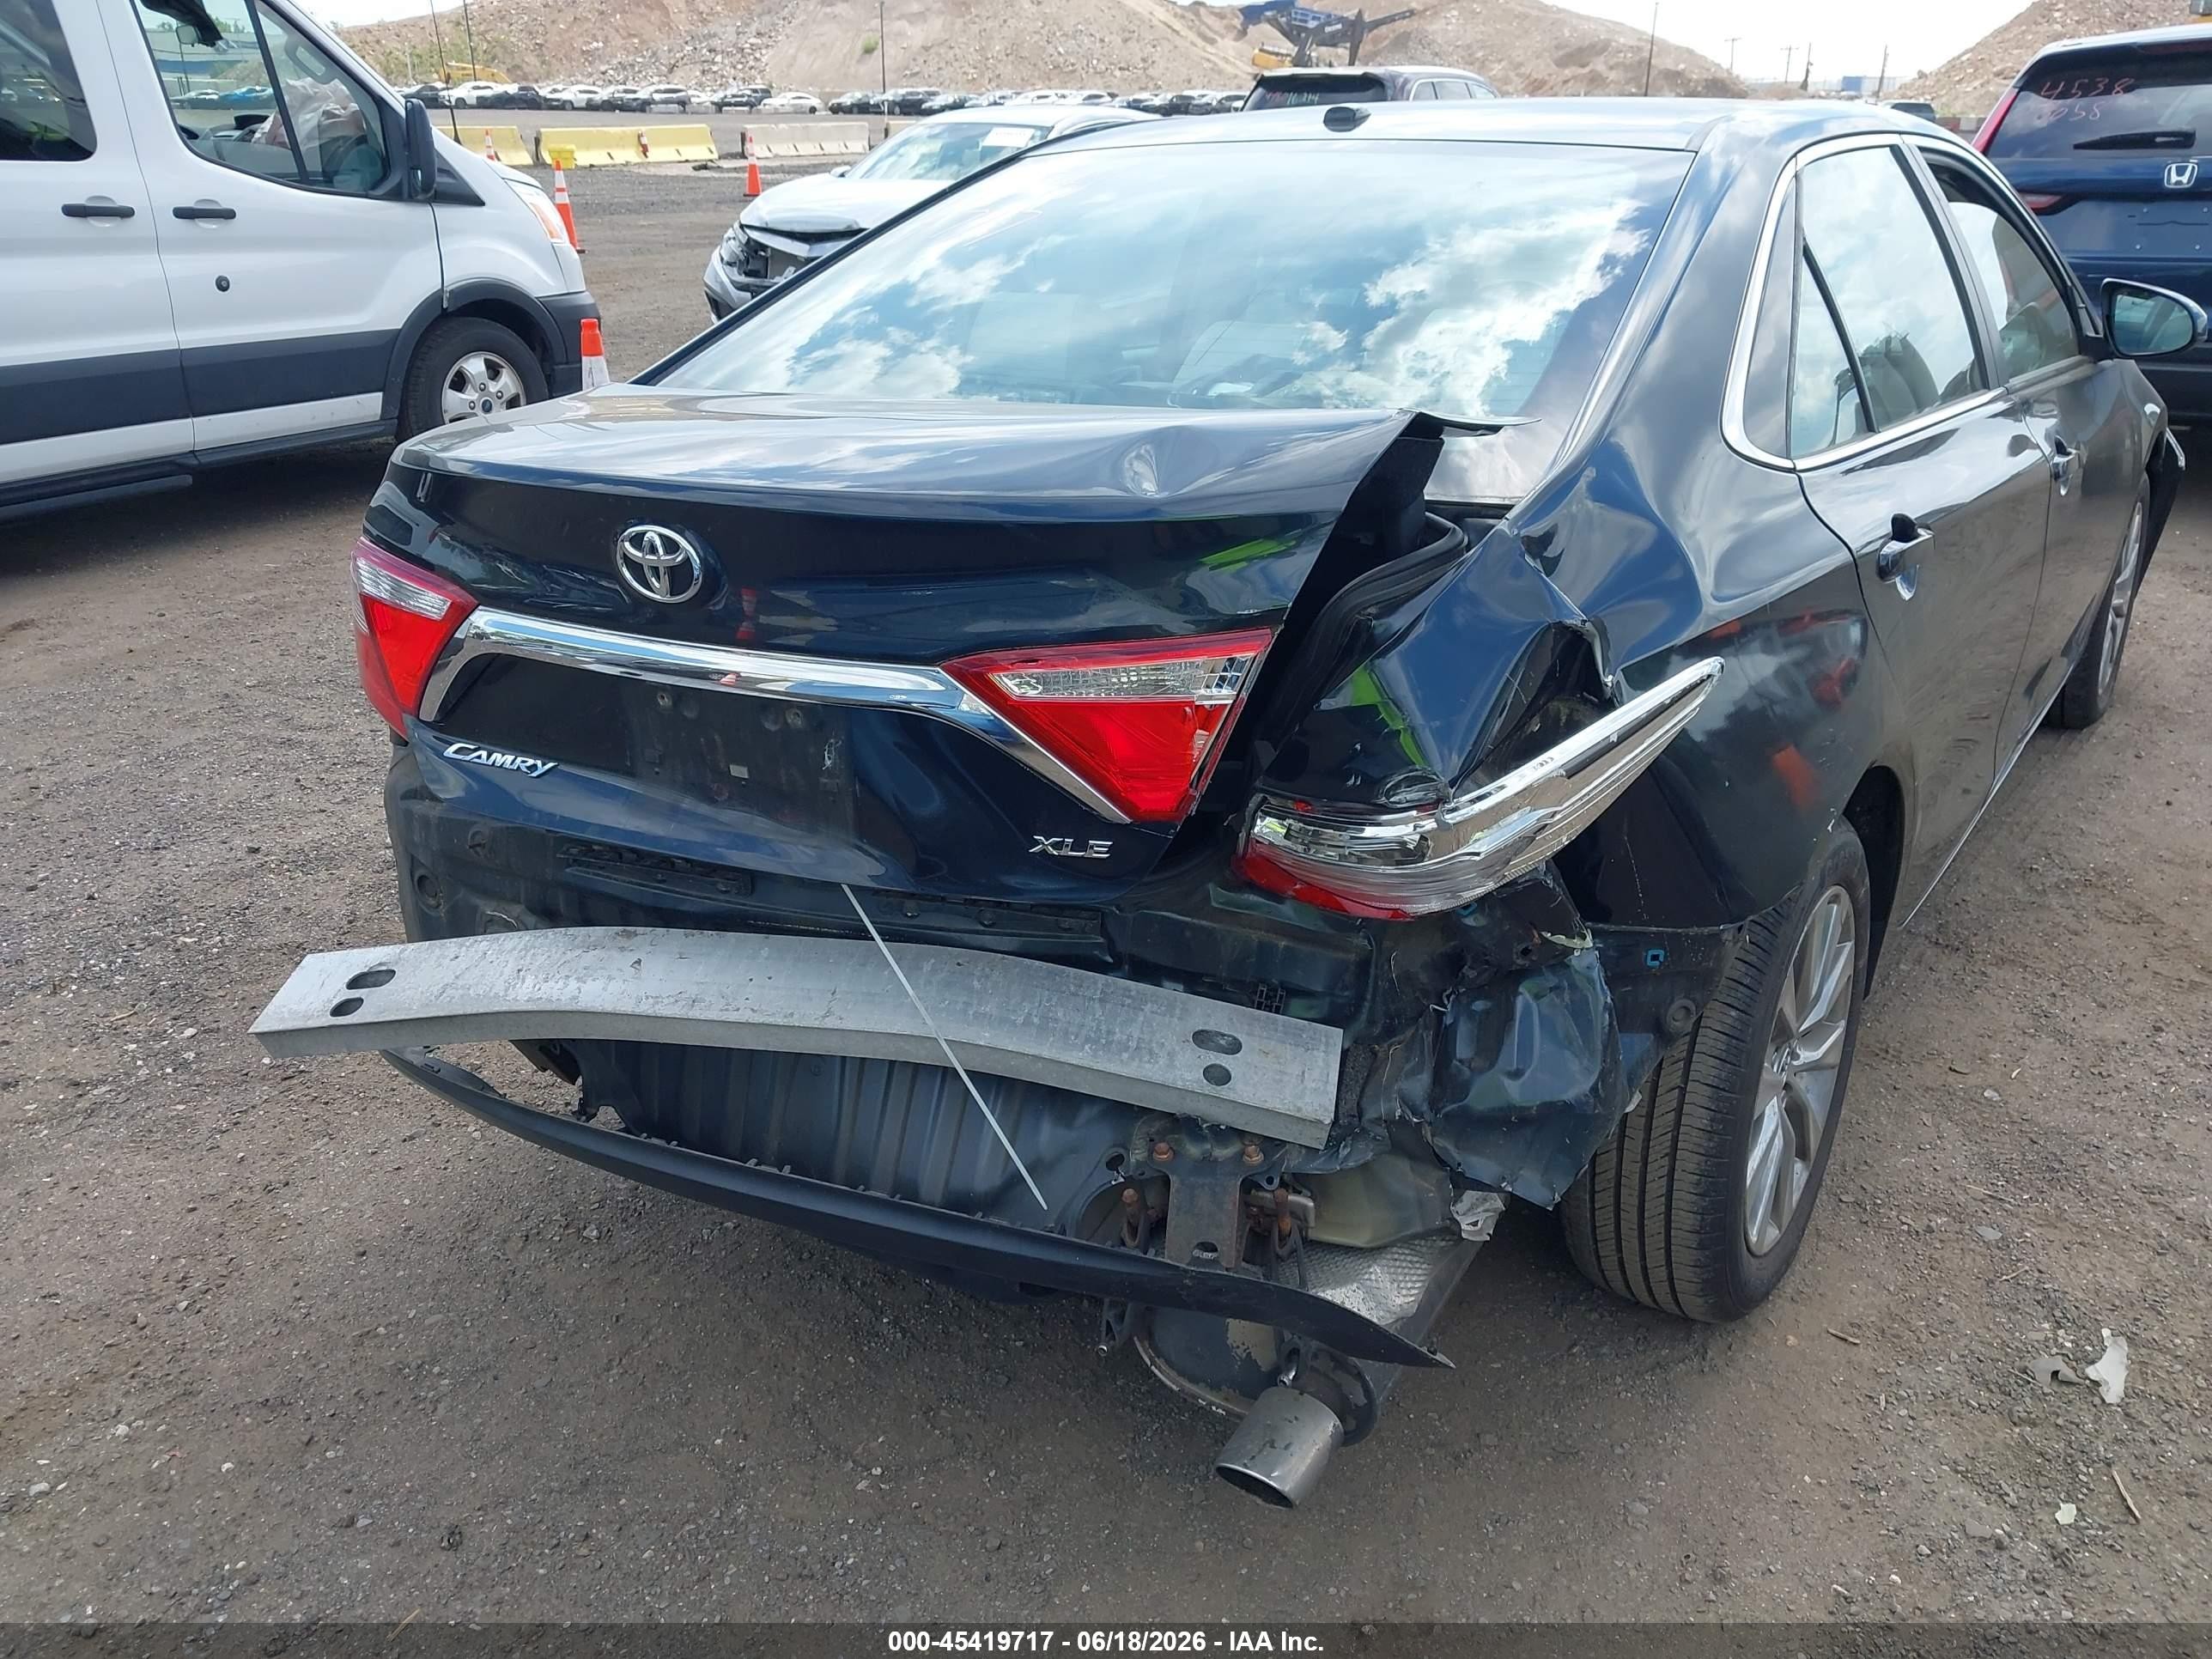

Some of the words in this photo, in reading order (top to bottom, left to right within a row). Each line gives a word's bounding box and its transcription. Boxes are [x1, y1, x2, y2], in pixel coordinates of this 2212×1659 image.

[2040, 76, 2135, 101] 4538
[443, 742, 559, 778] CAMRY
[1028, 835, 1113, 859] XLE
